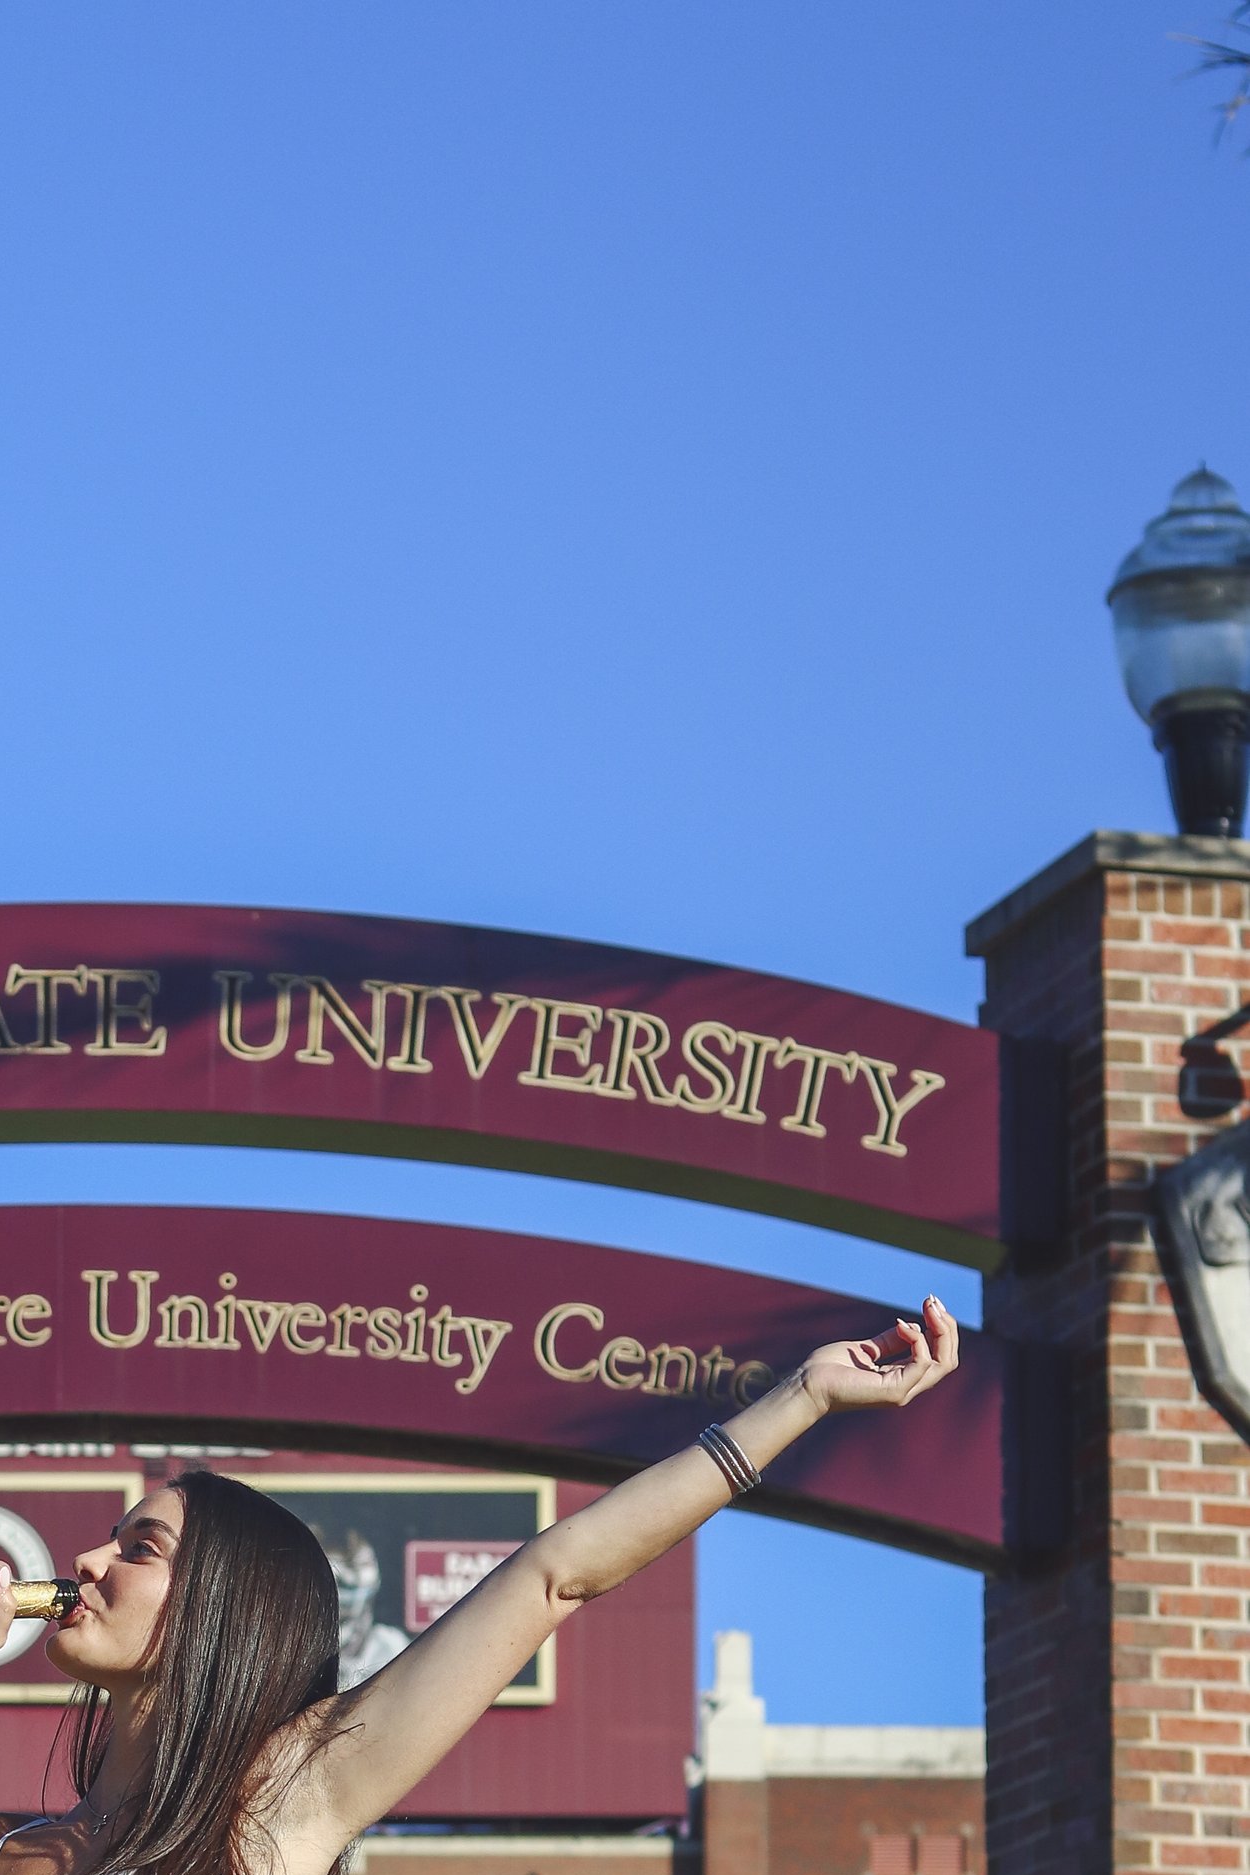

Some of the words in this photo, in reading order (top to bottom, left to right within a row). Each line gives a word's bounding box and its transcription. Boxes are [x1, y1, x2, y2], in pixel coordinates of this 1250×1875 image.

[213, 969, 945, 1157] UNIVERSITY
[80, 1269, 513, 1394] University
[533, 1302, 776, 1408] Cente
